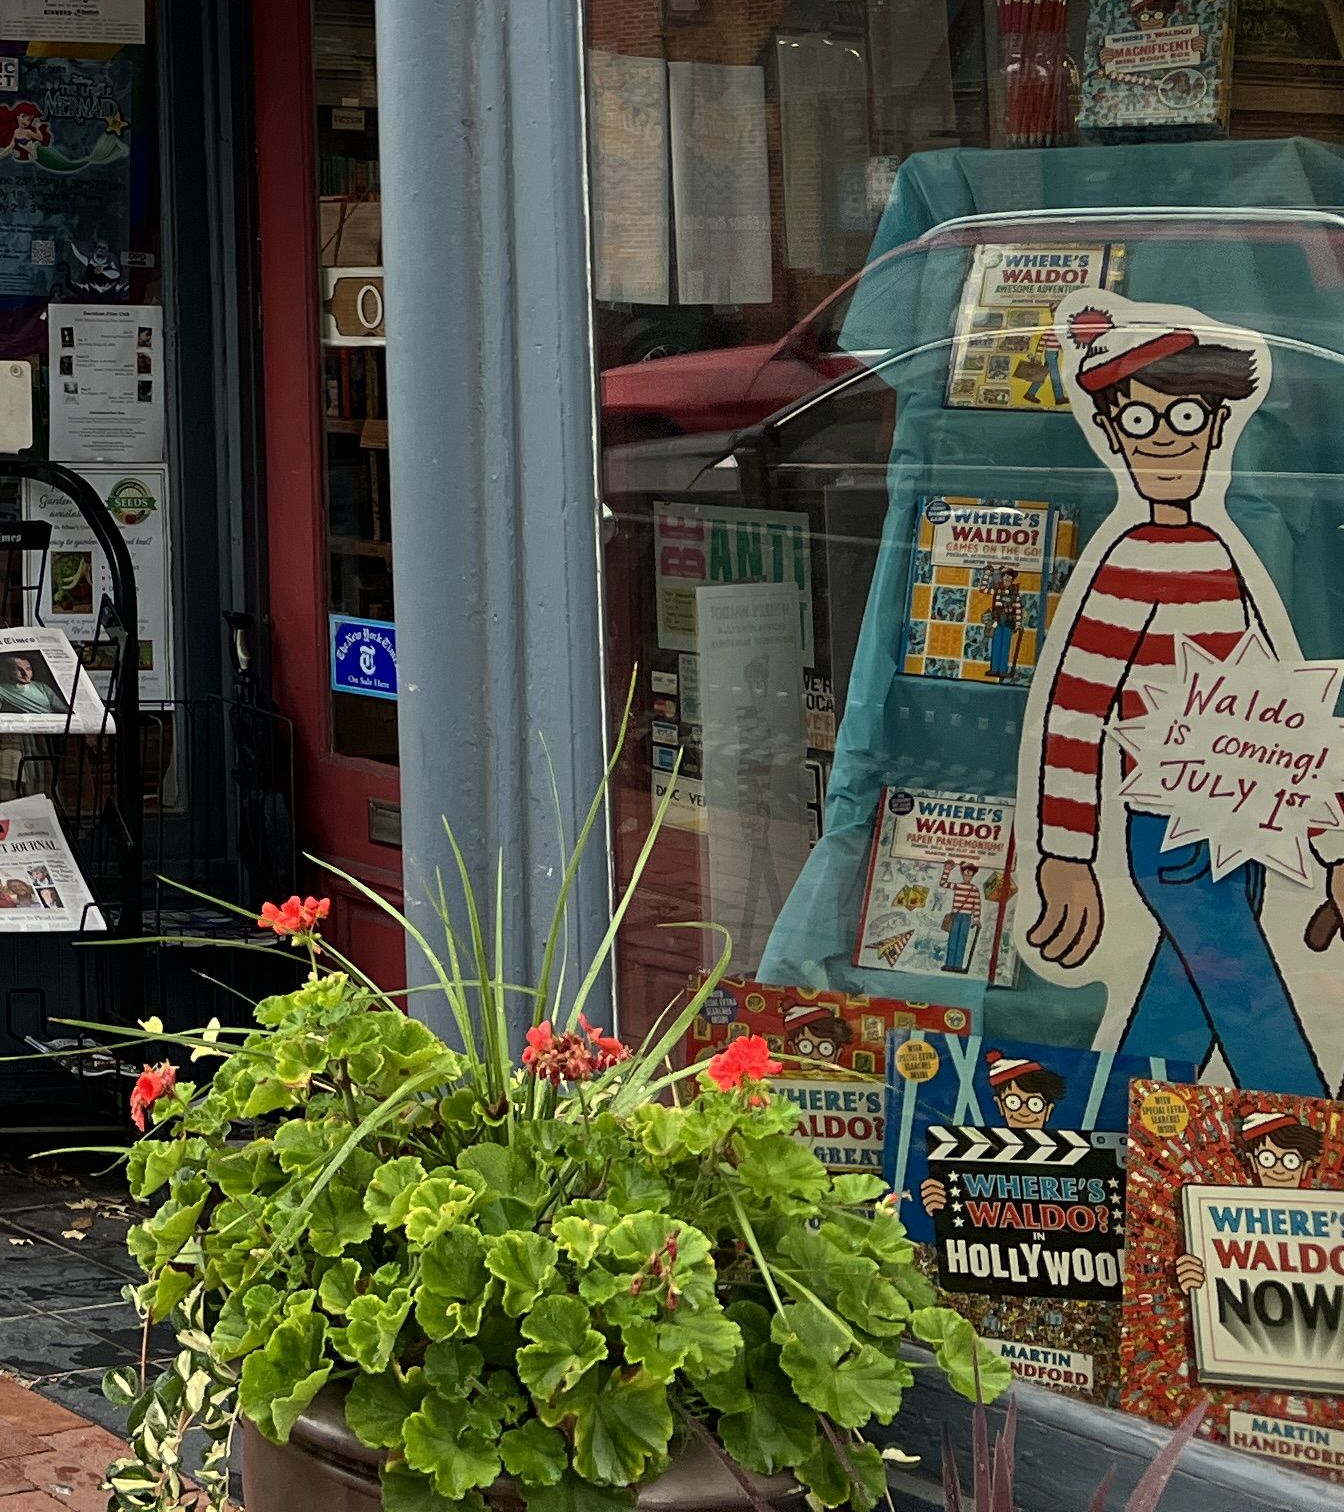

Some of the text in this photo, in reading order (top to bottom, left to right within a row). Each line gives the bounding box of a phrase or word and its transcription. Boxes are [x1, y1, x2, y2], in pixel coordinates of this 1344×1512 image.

[1112, 28, 1193, 44] WHERE'S WALDO?
[1113, 40, 1190, 58] MAGNIFICENT
[1115, 57, 1137, 65] MINI
[1139, 54, 1166, 63] BOOK
[43, 91, 120, 120] MERMAID
[1004, 254, 1090, 268] WHERE'S
[1001, 268, 1090, 285] WALDO?
[994, 284, 1036, 294] AWESOME
[114, 498, 149, 507] SEEDS
[953, 509, 1040, 528] WHERE'S
[951, 525, 1041, 546] WALDO?
[659, 513, 706, 581] BE
[945, 542, 978, 553] GAMES
[982, 544, 998, 555] ON
[1001, 545, 1021, 556] THE
[1023, 545, 1042, 557] GO!
[4, 636, 36, 645] Times
[347, 674, 390, 689] On Sale Here
[1183, 672, 1306, 730] Waldo
[1163, 719, 1330, 786] is coming!
[1159, 759, 1312, 832] JULY 1ST
[918, 801, 1004, 823] WHERE'S
[915, 817, 1002, 841] WALDO?
[906, 833, 1005, 852] PAPER PANDEMONIUM!
[720, 997, 737, 1006] EXTRA
[706, 1007, 732, 1016] SEARCHES
[711, 1016, 729, 1024] INSIDE
[907, 1044, 923, 1052] WITH
[897, 1051, 937, 1063] SPECIAL EXTRA
[904, 1061, 932, 1070] SEARCHES
[909, 1070, 929, 1079] INSIDE
[1155, 1096, 1171, 1105] WITH
[1142, 1105, 1186, 1115] SPECIAL EXTRA
[1151, 1115, 1180, 1125] SEARCHES
[1157, 1125, 1177, 1134] INSIDE
[962, 1173, 1107, 1203] WHERE'S
[965, 1200, 1110, 1234] WALDO?
[1032, 1232, 1046, 1241] IN
[1215, 1276, 1344, 1331] NOW
[1001, 1342, 1072, 1368] MARTIN
[1251, 1416, 1331, 1446] MARTIN
